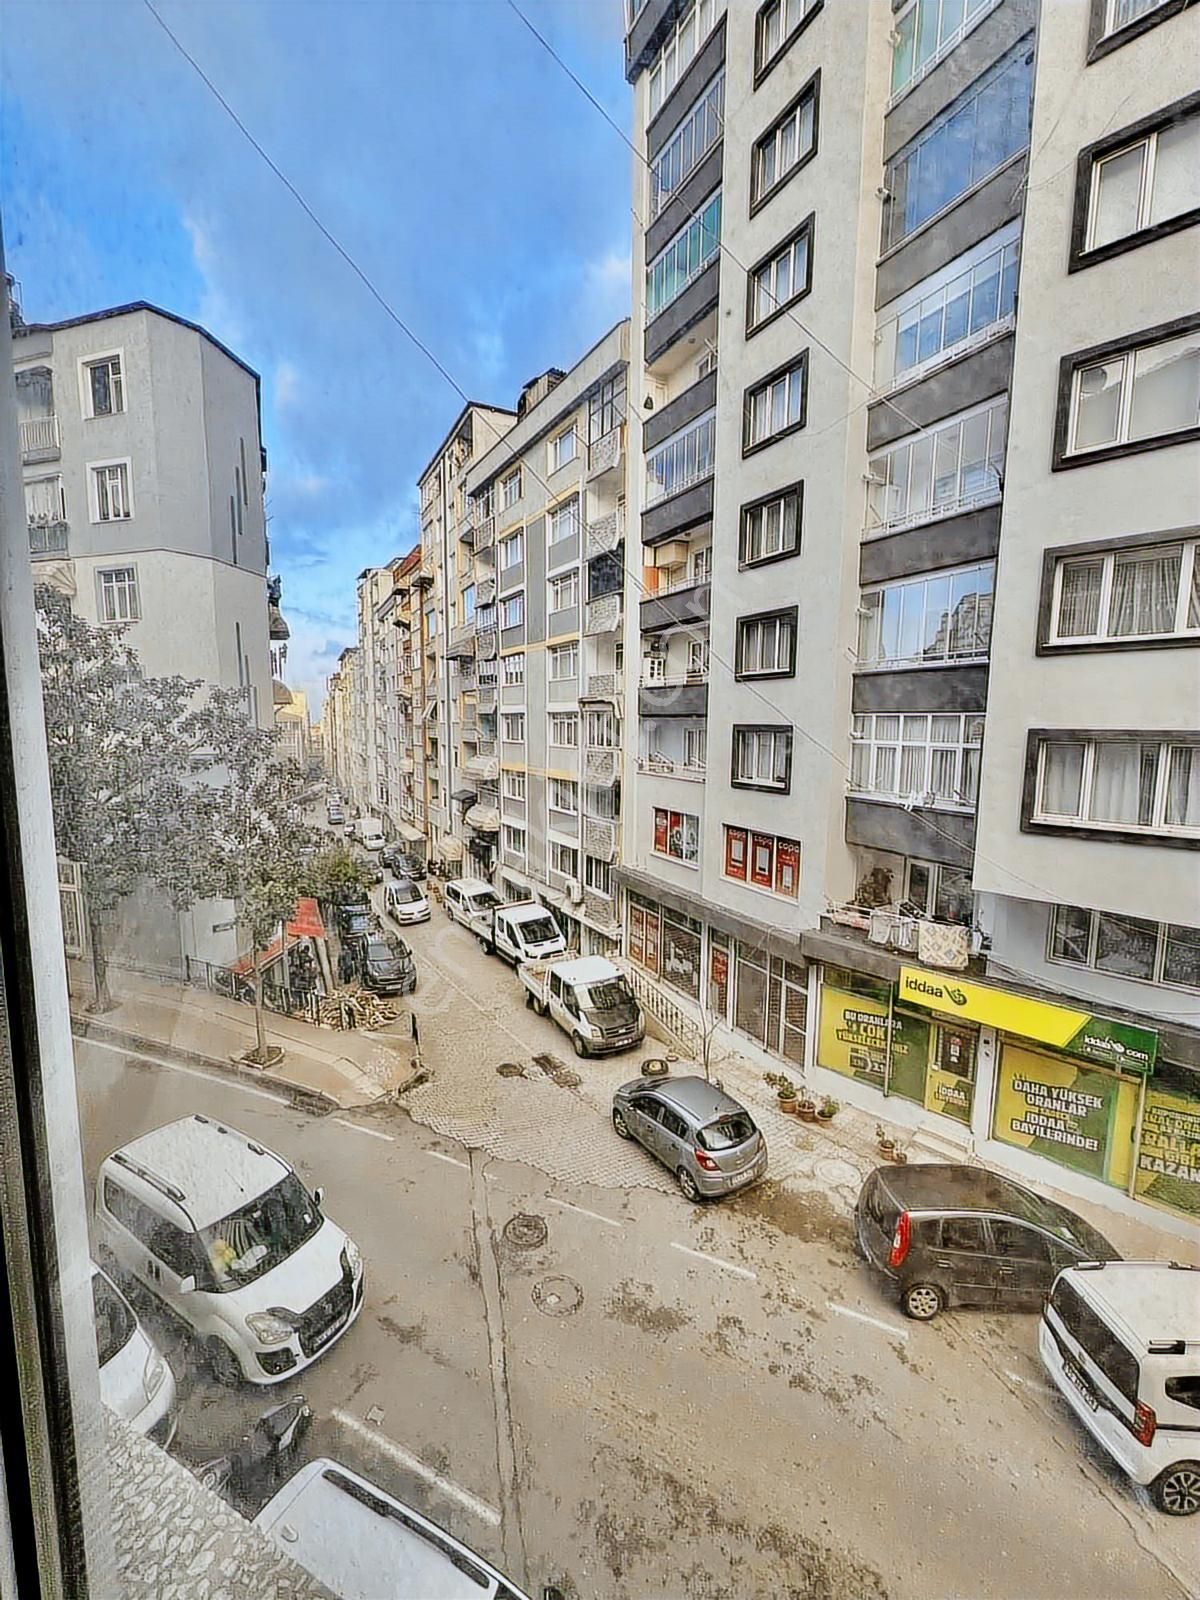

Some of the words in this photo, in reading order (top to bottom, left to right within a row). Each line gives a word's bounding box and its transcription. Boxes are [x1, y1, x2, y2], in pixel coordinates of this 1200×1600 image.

[778, 842, 800, 853] copa
[905, 976, 943, 998] iddaa
[1014, 1080, 1048, 1097] DAHA
[1051, 1087, 1104, 1109] YÜKSEK
[1026, 1093, 1087, 1117] ORANLAR
